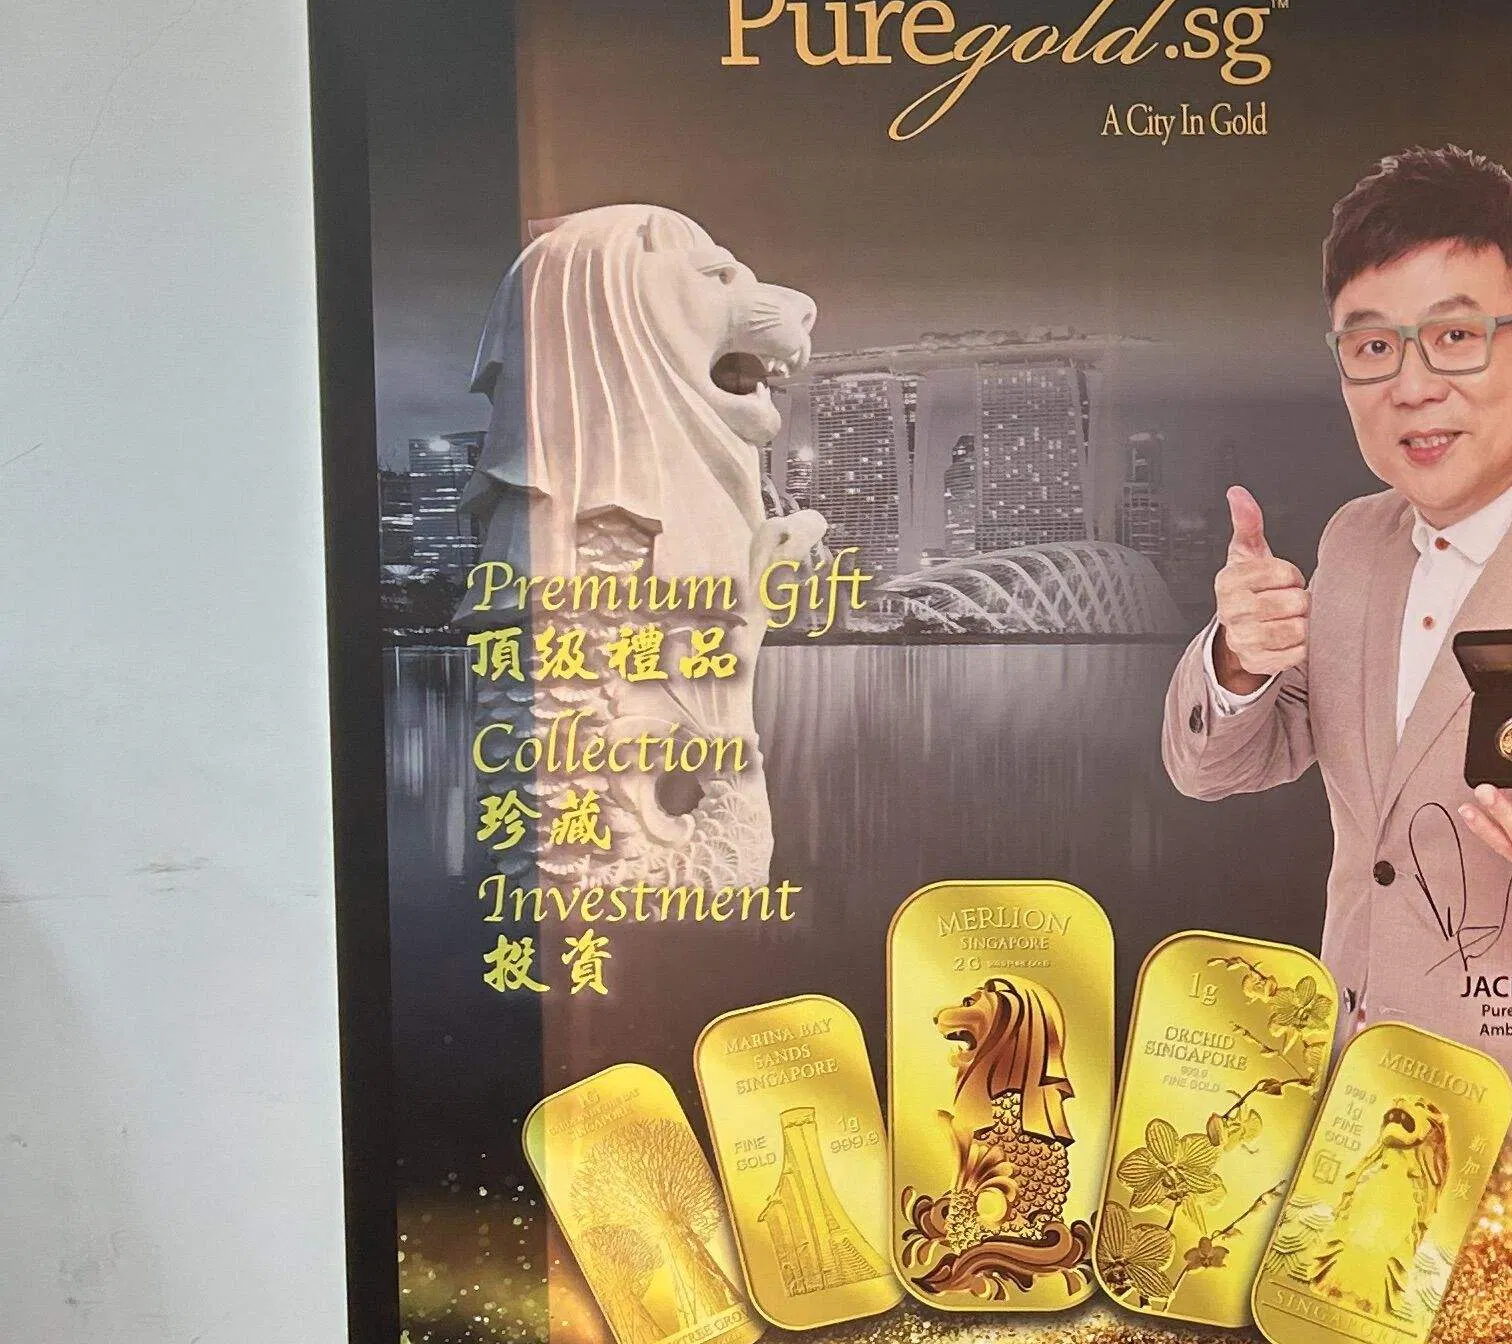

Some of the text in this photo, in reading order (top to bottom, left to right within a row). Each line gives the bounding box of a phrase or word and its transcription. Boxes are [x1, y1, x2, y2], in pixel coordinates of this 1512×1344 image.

[1101, 100, 1268, 146] A City In Gold
[467, 547, 874, 638] Premium Gift
[467, 624, 739, 682] 頂級禮品
[472, 709, 748, 775] Collection
[476, 789, 612, 851] 珍藏
[478, 874, 803, 923] Investment
[937, 905, 1073, 937] MERLION
[960, 936, 1050, 951] SINGAPORE
[483, 928, 613, 995] 投資
[1188, 971, 1218, 1006] 1g
[723, 1017, 833, 1055] MARINA BAY
[1165, 1026, 1236, 1051] ORCHID
[753, 1043, 812, 1069] SANDS
[1144, 1040, 1248, 1071] SINGAPORE
[736, 1058, 839, 1095] SINGAPORE
[1379, 1048, 1488, 1103] MERLION
[838, 1113, 861, 1133] 1g
[1332, 1116, 1364, 1137] FINE
[734, 1136, 768, 1155] FINE
[830, 1130, 880, 1154] 999.9
[1325, 1130, 1362, 1151] GOLD
[736, 1152, 777, 1171] GOLD
